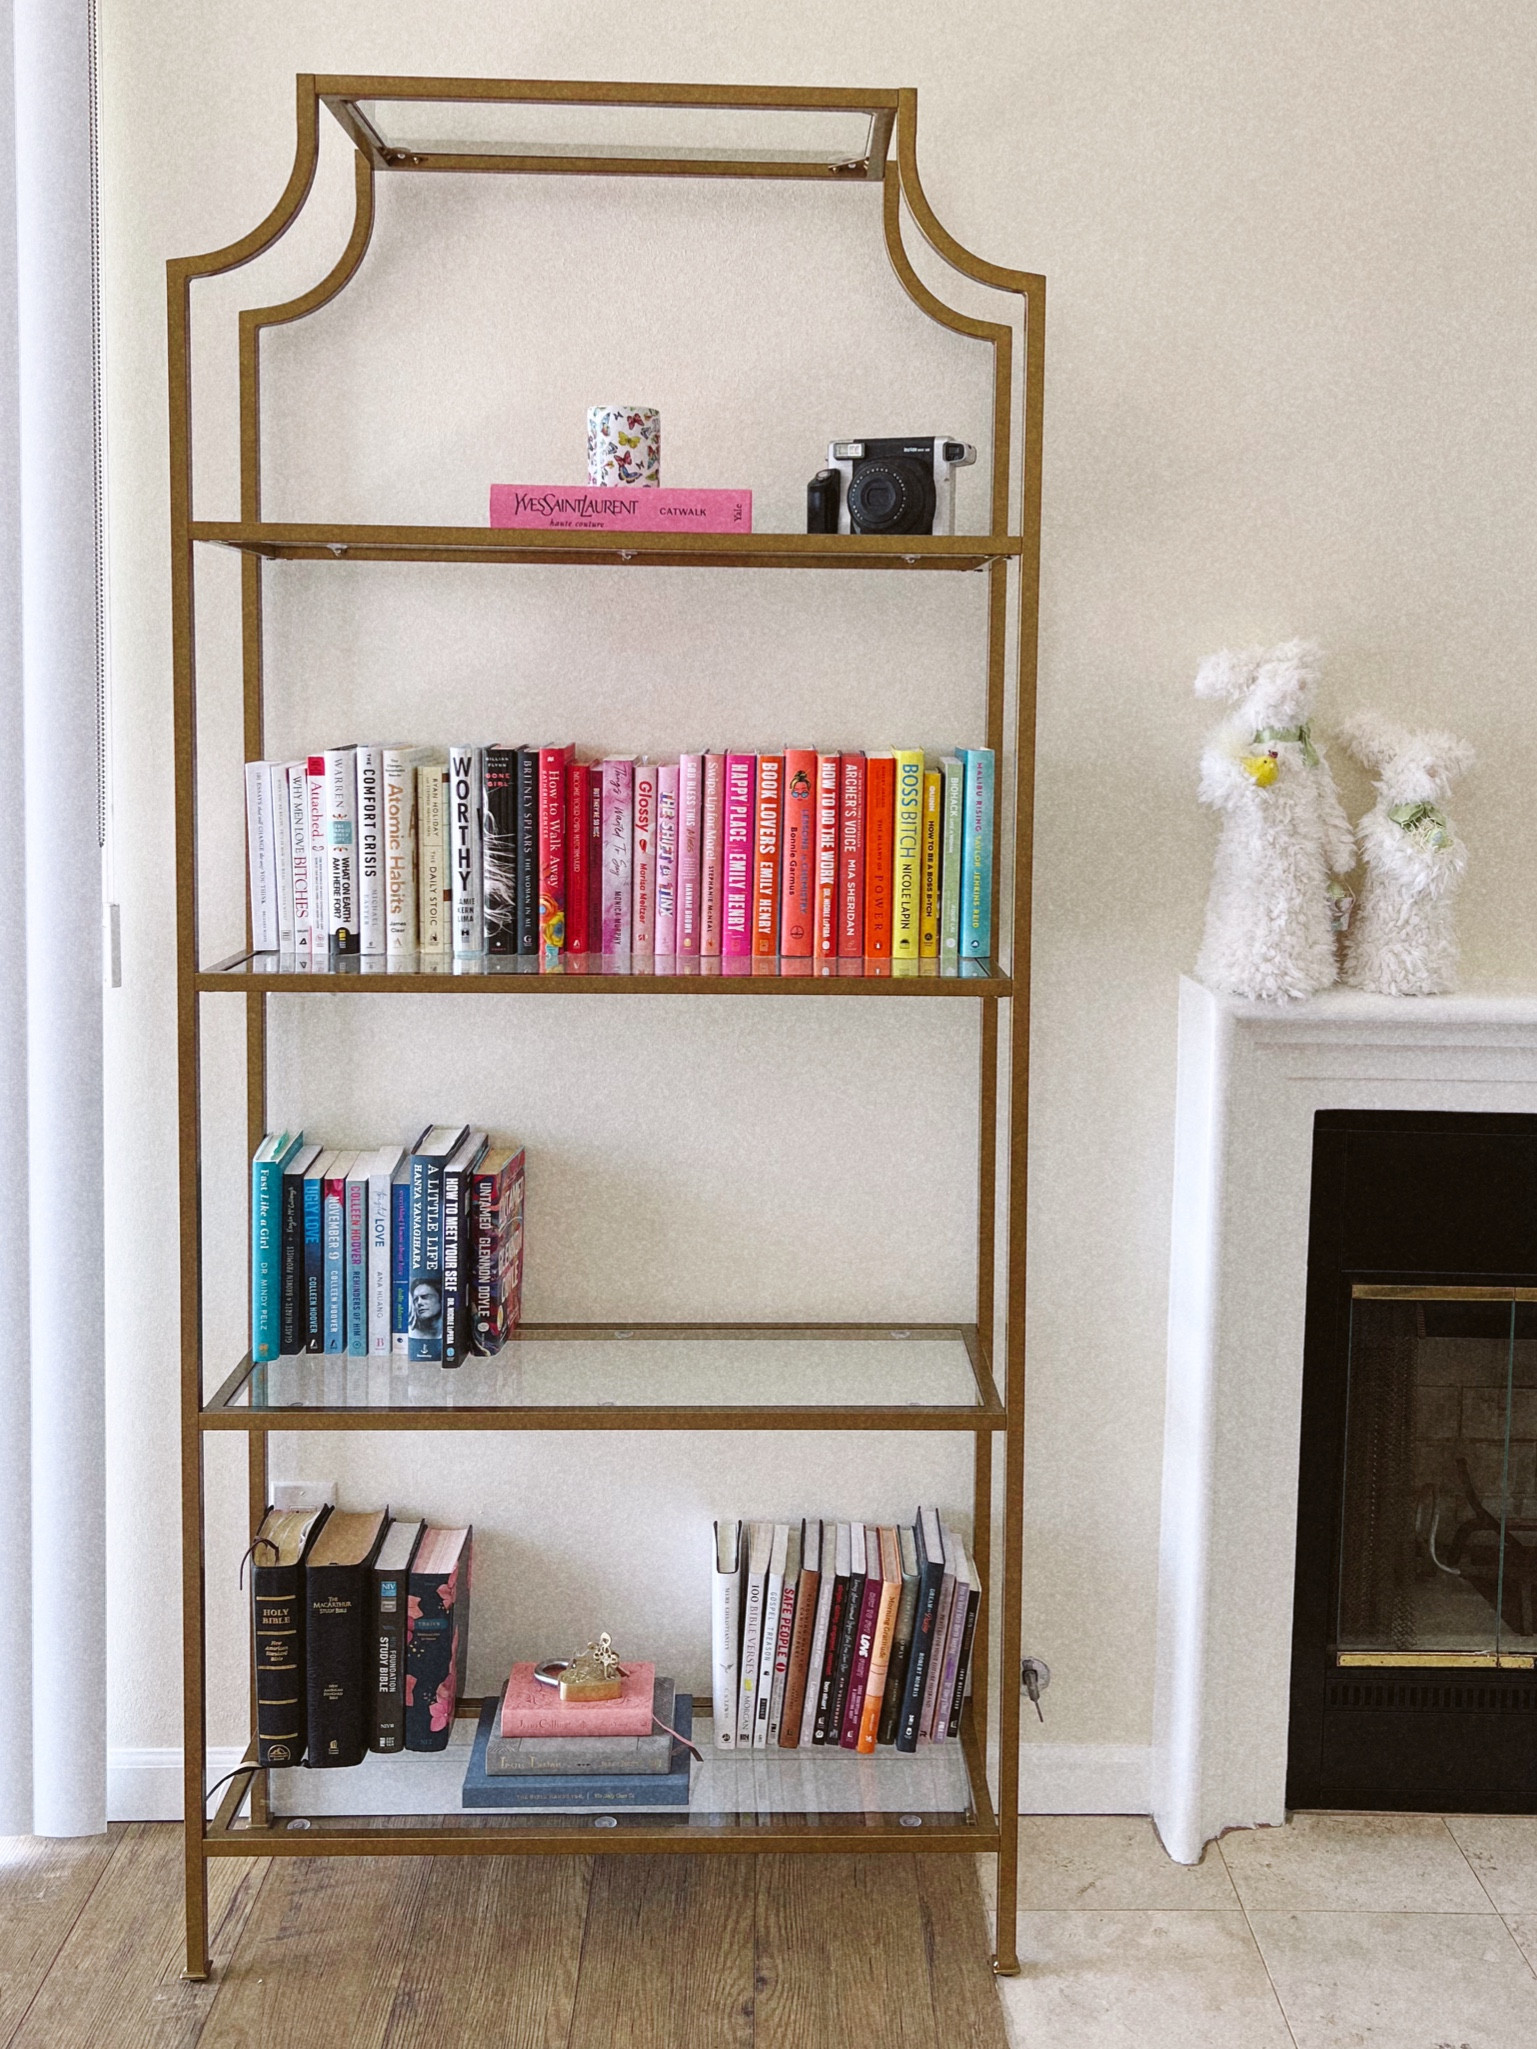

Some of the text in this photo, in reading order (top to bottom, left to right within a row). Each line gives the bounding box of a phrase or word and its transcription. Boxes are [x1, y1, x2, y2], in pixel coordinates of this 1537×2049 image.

[550, 520, 605, 528] haute couture
[659, 507, 707, 517] CATWALK
[734, 504, 742, 522] Yale
[334, 759, 344, 808] WARREN
[363, 769, 376, 828] COMFORT
[523, 761, 532, 808] BRITNEY
[686, 781, 696, 806] BLESS
[687, 762, 696, 778] GOD
[950, 777, 959, 816] BIOHACK
[388, 783, 404, 850] Atomic
[453, 757, 472, 891] WORTHY
[523, 813, 532, 852] SPEARS
[548, 770, 561, 887] How to Walk Away
[635, 781, 652, 832] Glossy
[686, 808, 695, 826] THIS
[706, 762, 718, 860] Swipe Up for More!
[820, 763, 835, 884] HOW TO DO THE WORK
[844, 764, 858, 852] ARCHER'S VOICE
[900, 764, 919, 857] BOSS BITCH
[293, 776, 307, 918] WHY MEN LOVE BITCHES
[364, 835, 377, 877] CRISIS
[639, 863, 647, 890] Marisa
[727, 764, 748, 932] HAPPY PLACE EMILY HENRY
[758, 762, 778, 934] BOOK LOVERS EMILY HENRY
[789, 827, 798, 895] Bonnie Garmus
[341, 857, 351, 922] WHAT ON EARTH
[390, 856, 405, 914] Habits
[429, 867, 437, 892] DAILY
[684, 883, 693, 908] HANNAH
[846, 859, 856, 935] MIA SHERIDAN
[901, 864, 912, 929] NICOLE LAPIN
[972, 835, 982, 928] TAYLOR JENKINS REID
[526, 907, 531, 915] IN
[260, 1169, 269, 1190] Fast
[260, 1194, 269, 1217] Like
[479, 1182, 492, 1230] UNTAMED
[260, 1228, 269, 1249] Girl
[304, 1185, 319, 1243] UGLY LOVE
[328, 1196, 340, 1259] NOVEMBER 9
[351, 1185, 361, 1265] COLLEEN HOOVER
[412, 1164, 422, 1269] HANYA YANAGIHARA
[426, 1164, 438, 1270] A LITTLE LIFE
[445, 1178, 459, 1291] HOW TO MEET YOUR SELF
[309, 1276, 318, 1333] COLLEEN HOOVER
[330, 1270, 338, 1332] COLLEEN HOOVER
[352, 1271, 361, 1336] REMINDERS OF HIM
[376, 1291, 384, 1318] HUANG
[477, 1237, 491, 1316] GLENNON DOYLE
[745, 1584, 759, 1674] 100 BIBLE VERSES
[764, 1592, 777, 1660] GOSPEL TREASON
[777, 1588, 794, 1657] SAFE PEOPLE
[879, 1596, 896, 1658] Morning Gratitude
[379, 1636, 388, 1692] STUDY BIBLE
[912, 1653, 925, 1697] ROBERT MORRIS
[741, 1695, 751, 1730] MORGAN
